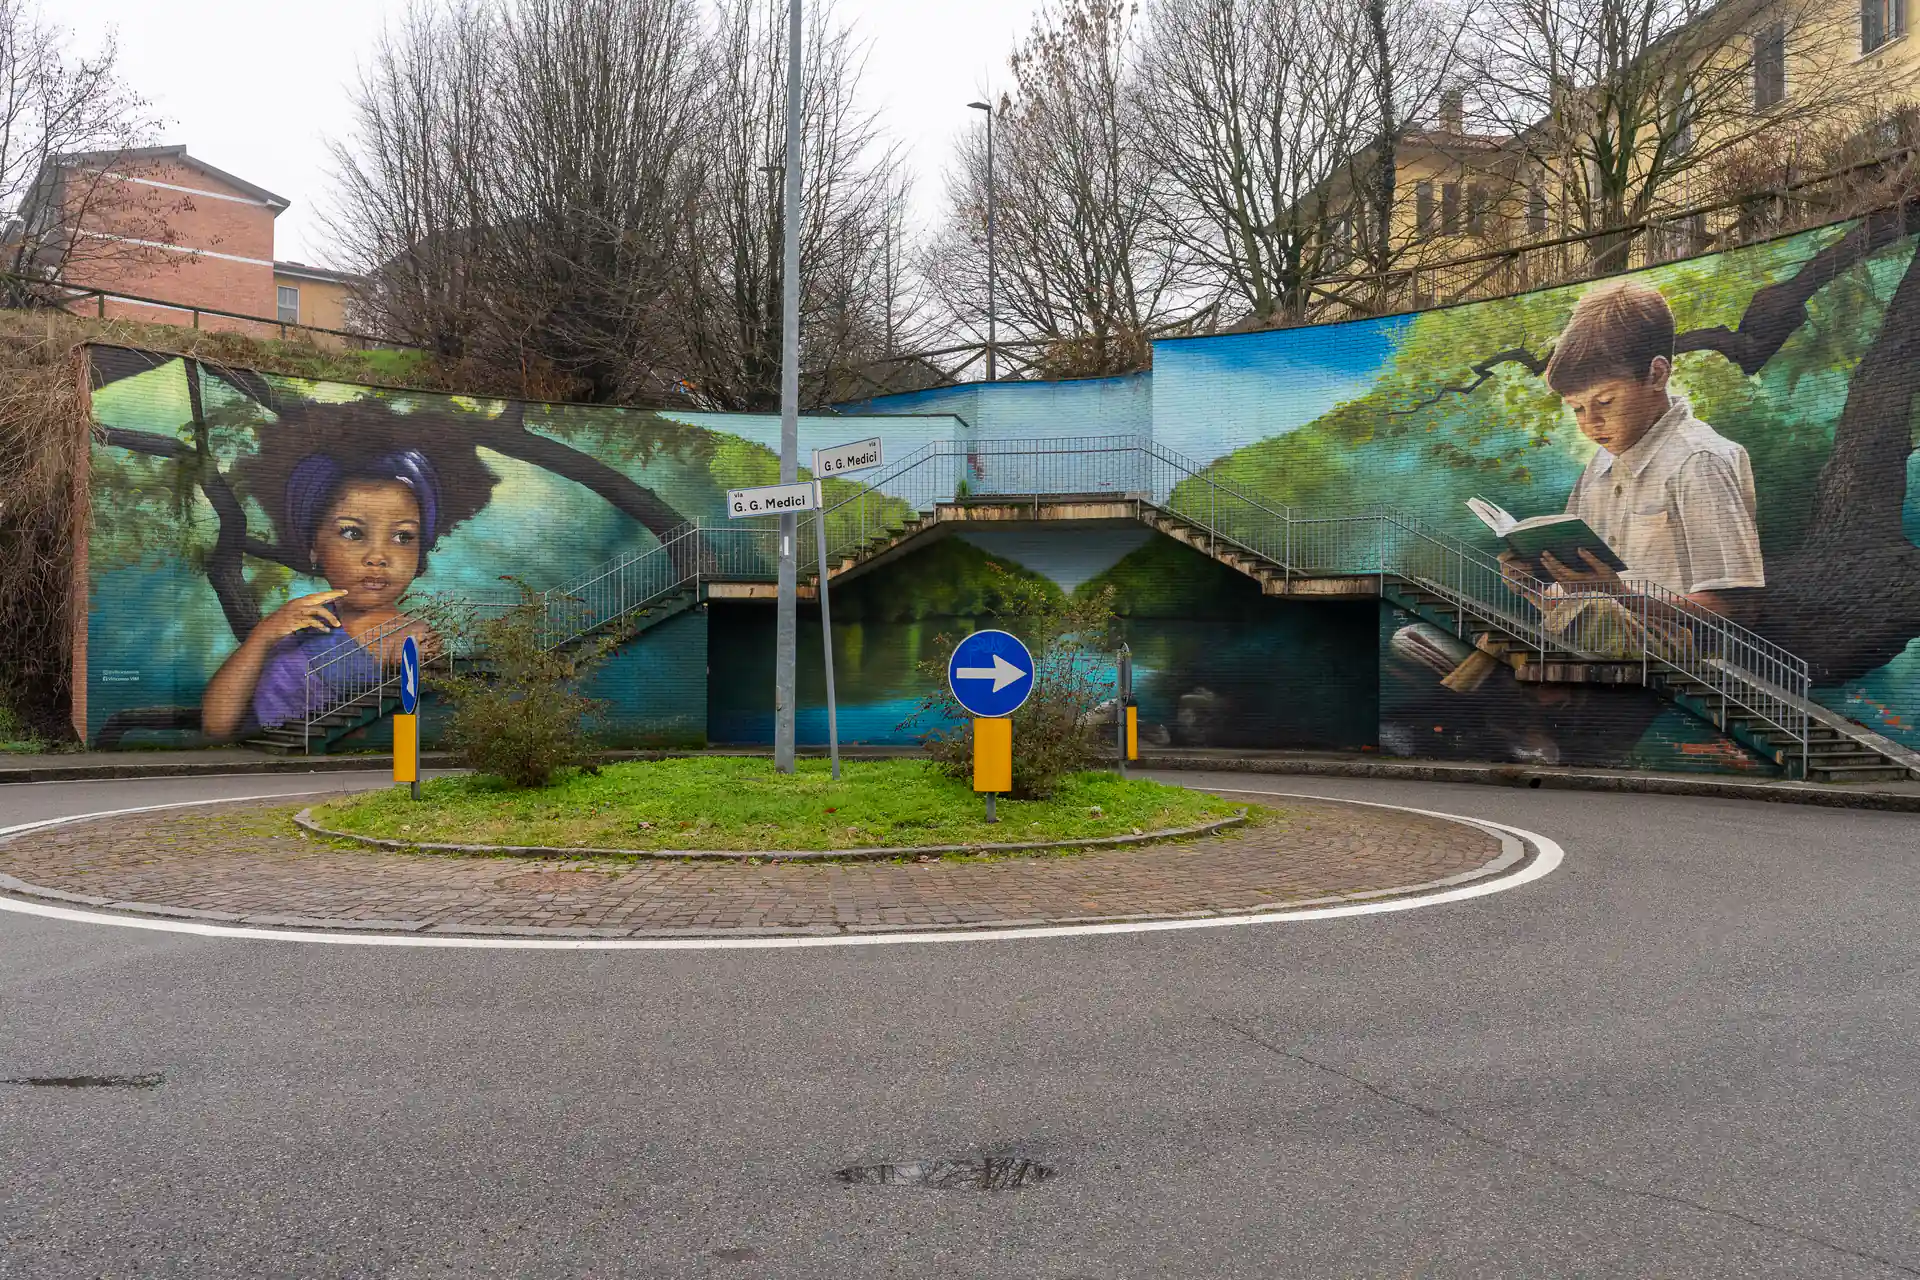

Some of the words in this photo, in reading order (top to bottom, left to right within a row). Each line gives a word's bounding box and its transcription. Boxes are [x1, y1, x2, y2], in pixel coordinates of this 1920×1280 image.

[824, 461, 835, 471] G.
[836, 459, 846, 469] G.
[847, 451, 877, 467] Medici
[734, 502, 747, 513] G.
[749, 500, 762, 511] G.
[765, 495, 805, 509] Medici
